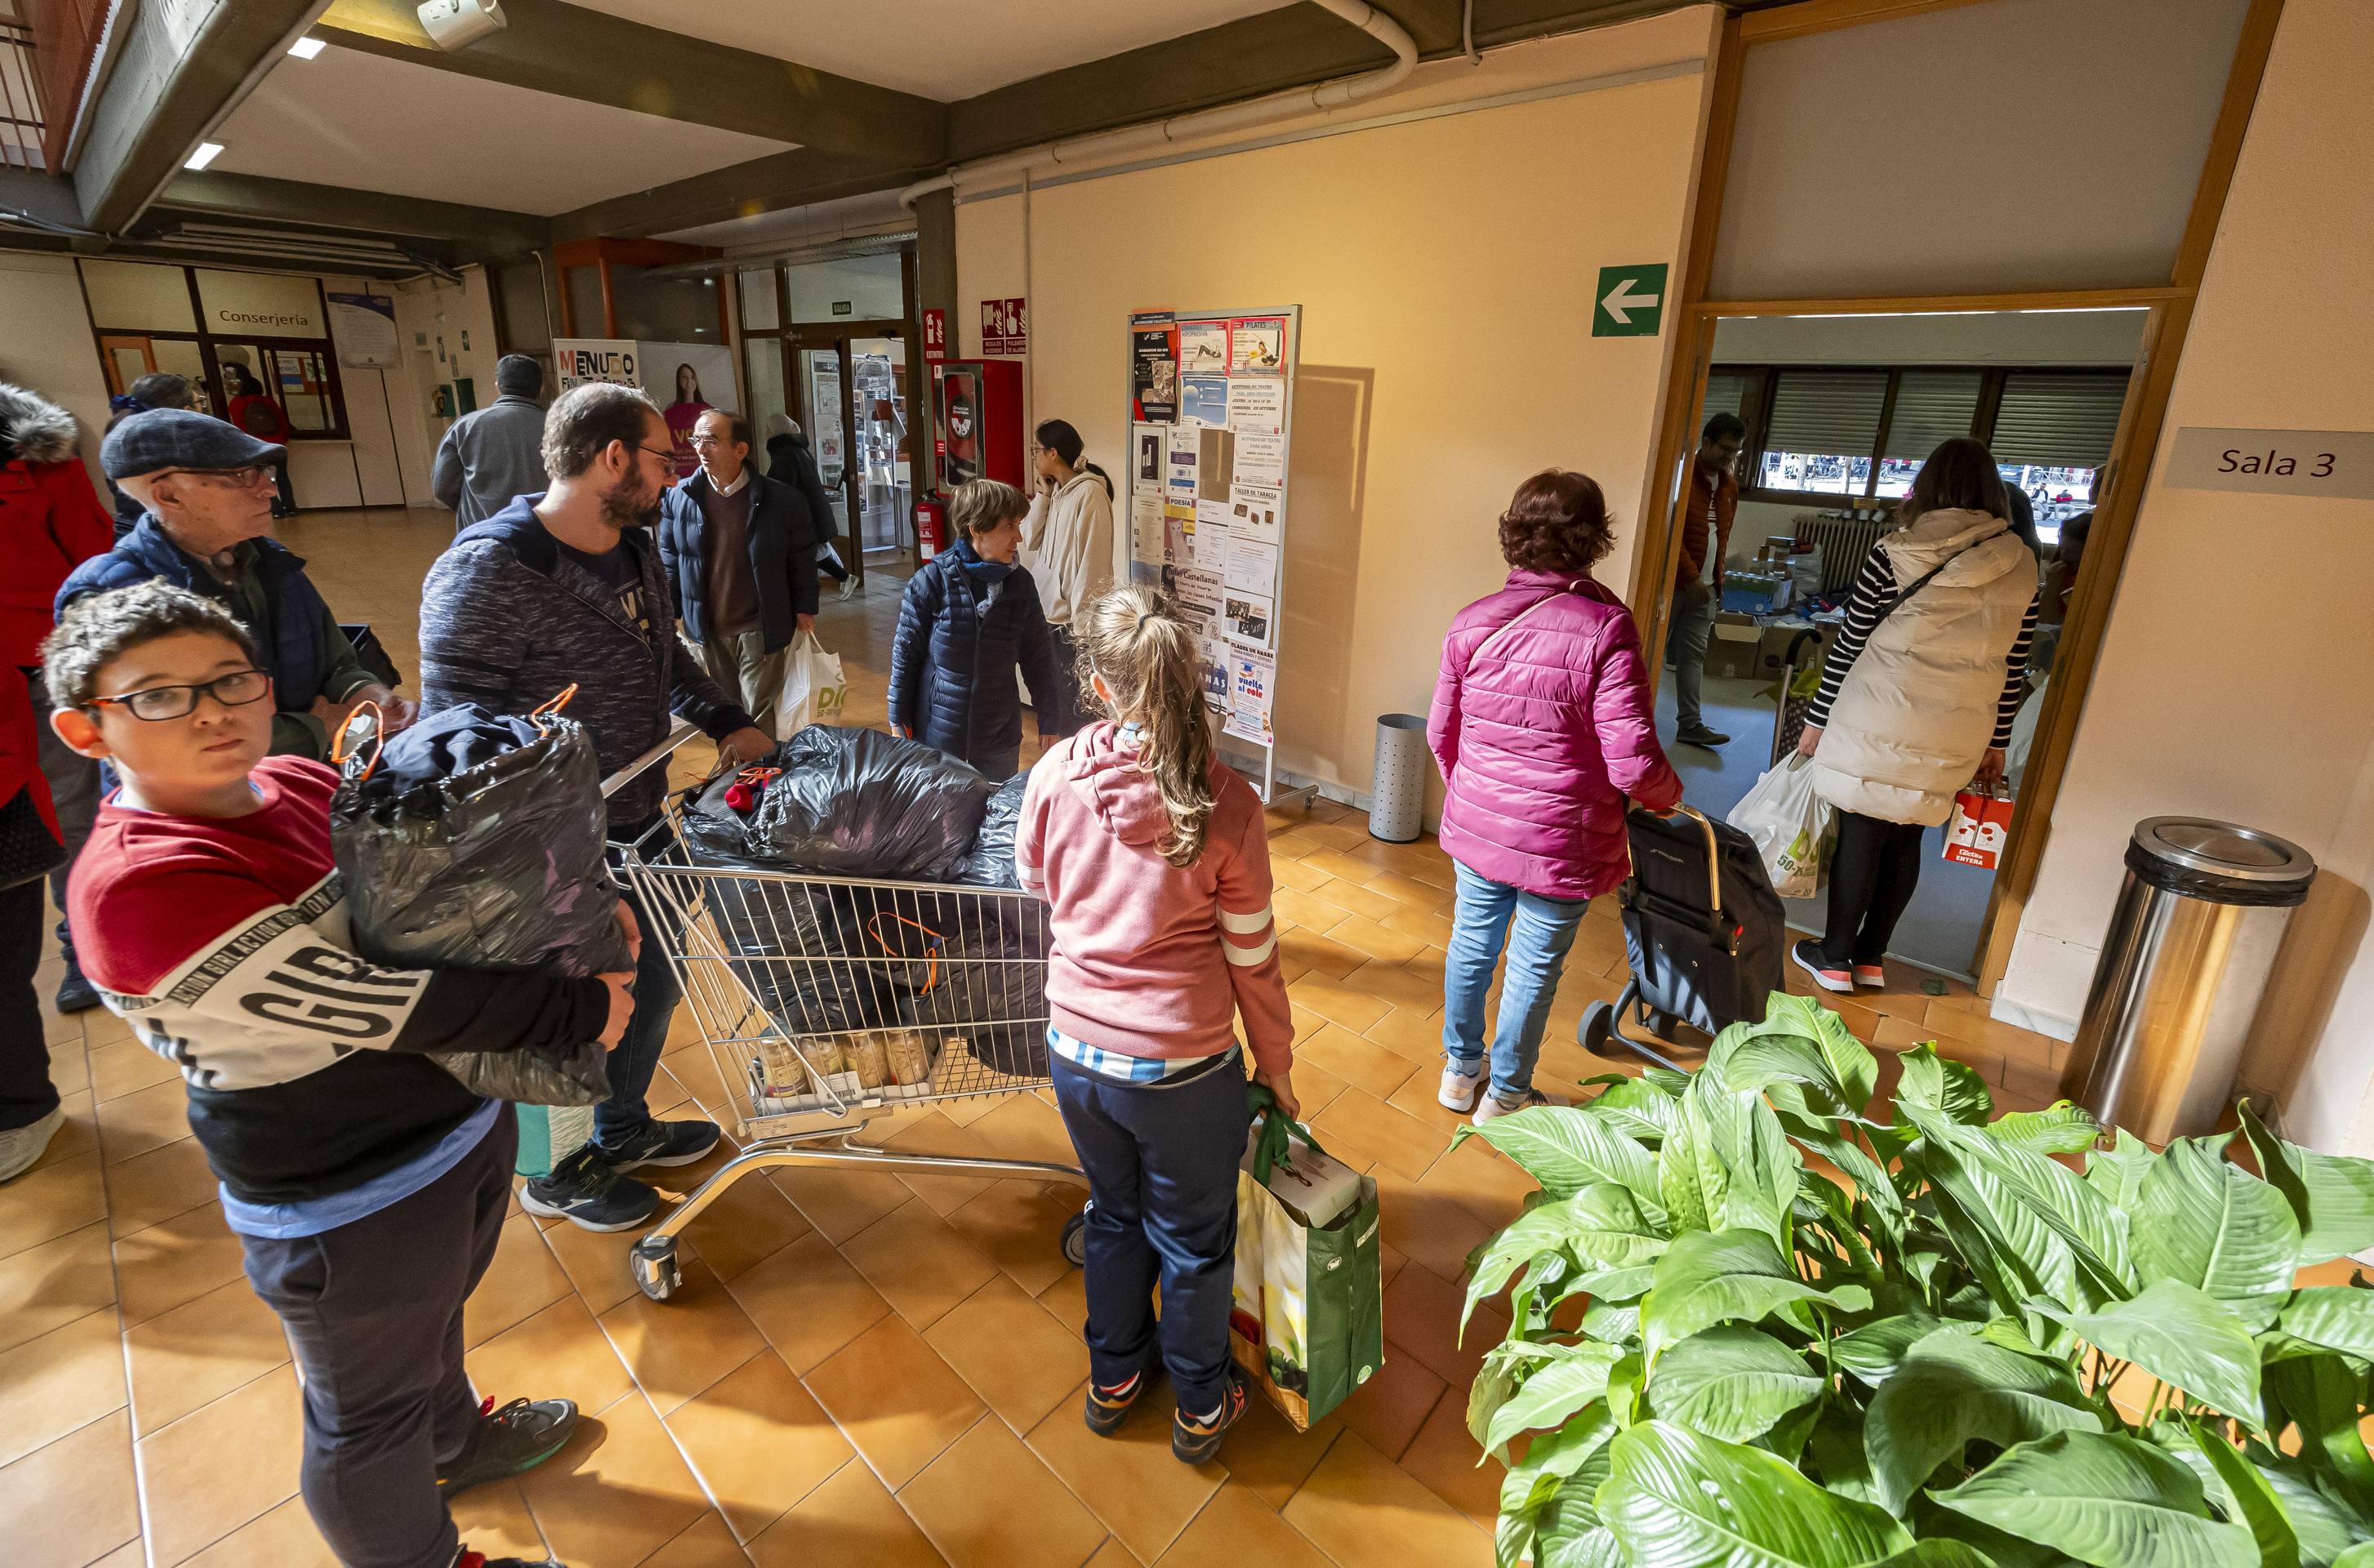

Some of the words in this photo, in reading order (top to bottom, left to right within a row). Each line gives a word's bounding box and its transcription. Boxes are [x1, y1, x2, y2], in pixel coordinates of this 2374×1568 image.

[220, 310, 308, 327] Conserjería
[559, 350, 635, 376] MENUDO
[2217, 449, 2296, 476] Sala
[2309, 452, 2336, 478] 3
[1170, 498, 1191, 506] POESÍA
[1257, 491, 1277, 499] TARACEA
[1183, 571, 1218, 586] Castellanas
[1238, 676, 1263, 690] vuelta
[1246, 687, 1263, 699] cole
[1955, 855, 1984, 866] ENTERA
[203, 949, 245, 974] GIRL
[232, 918, 285, 958] ACTION
